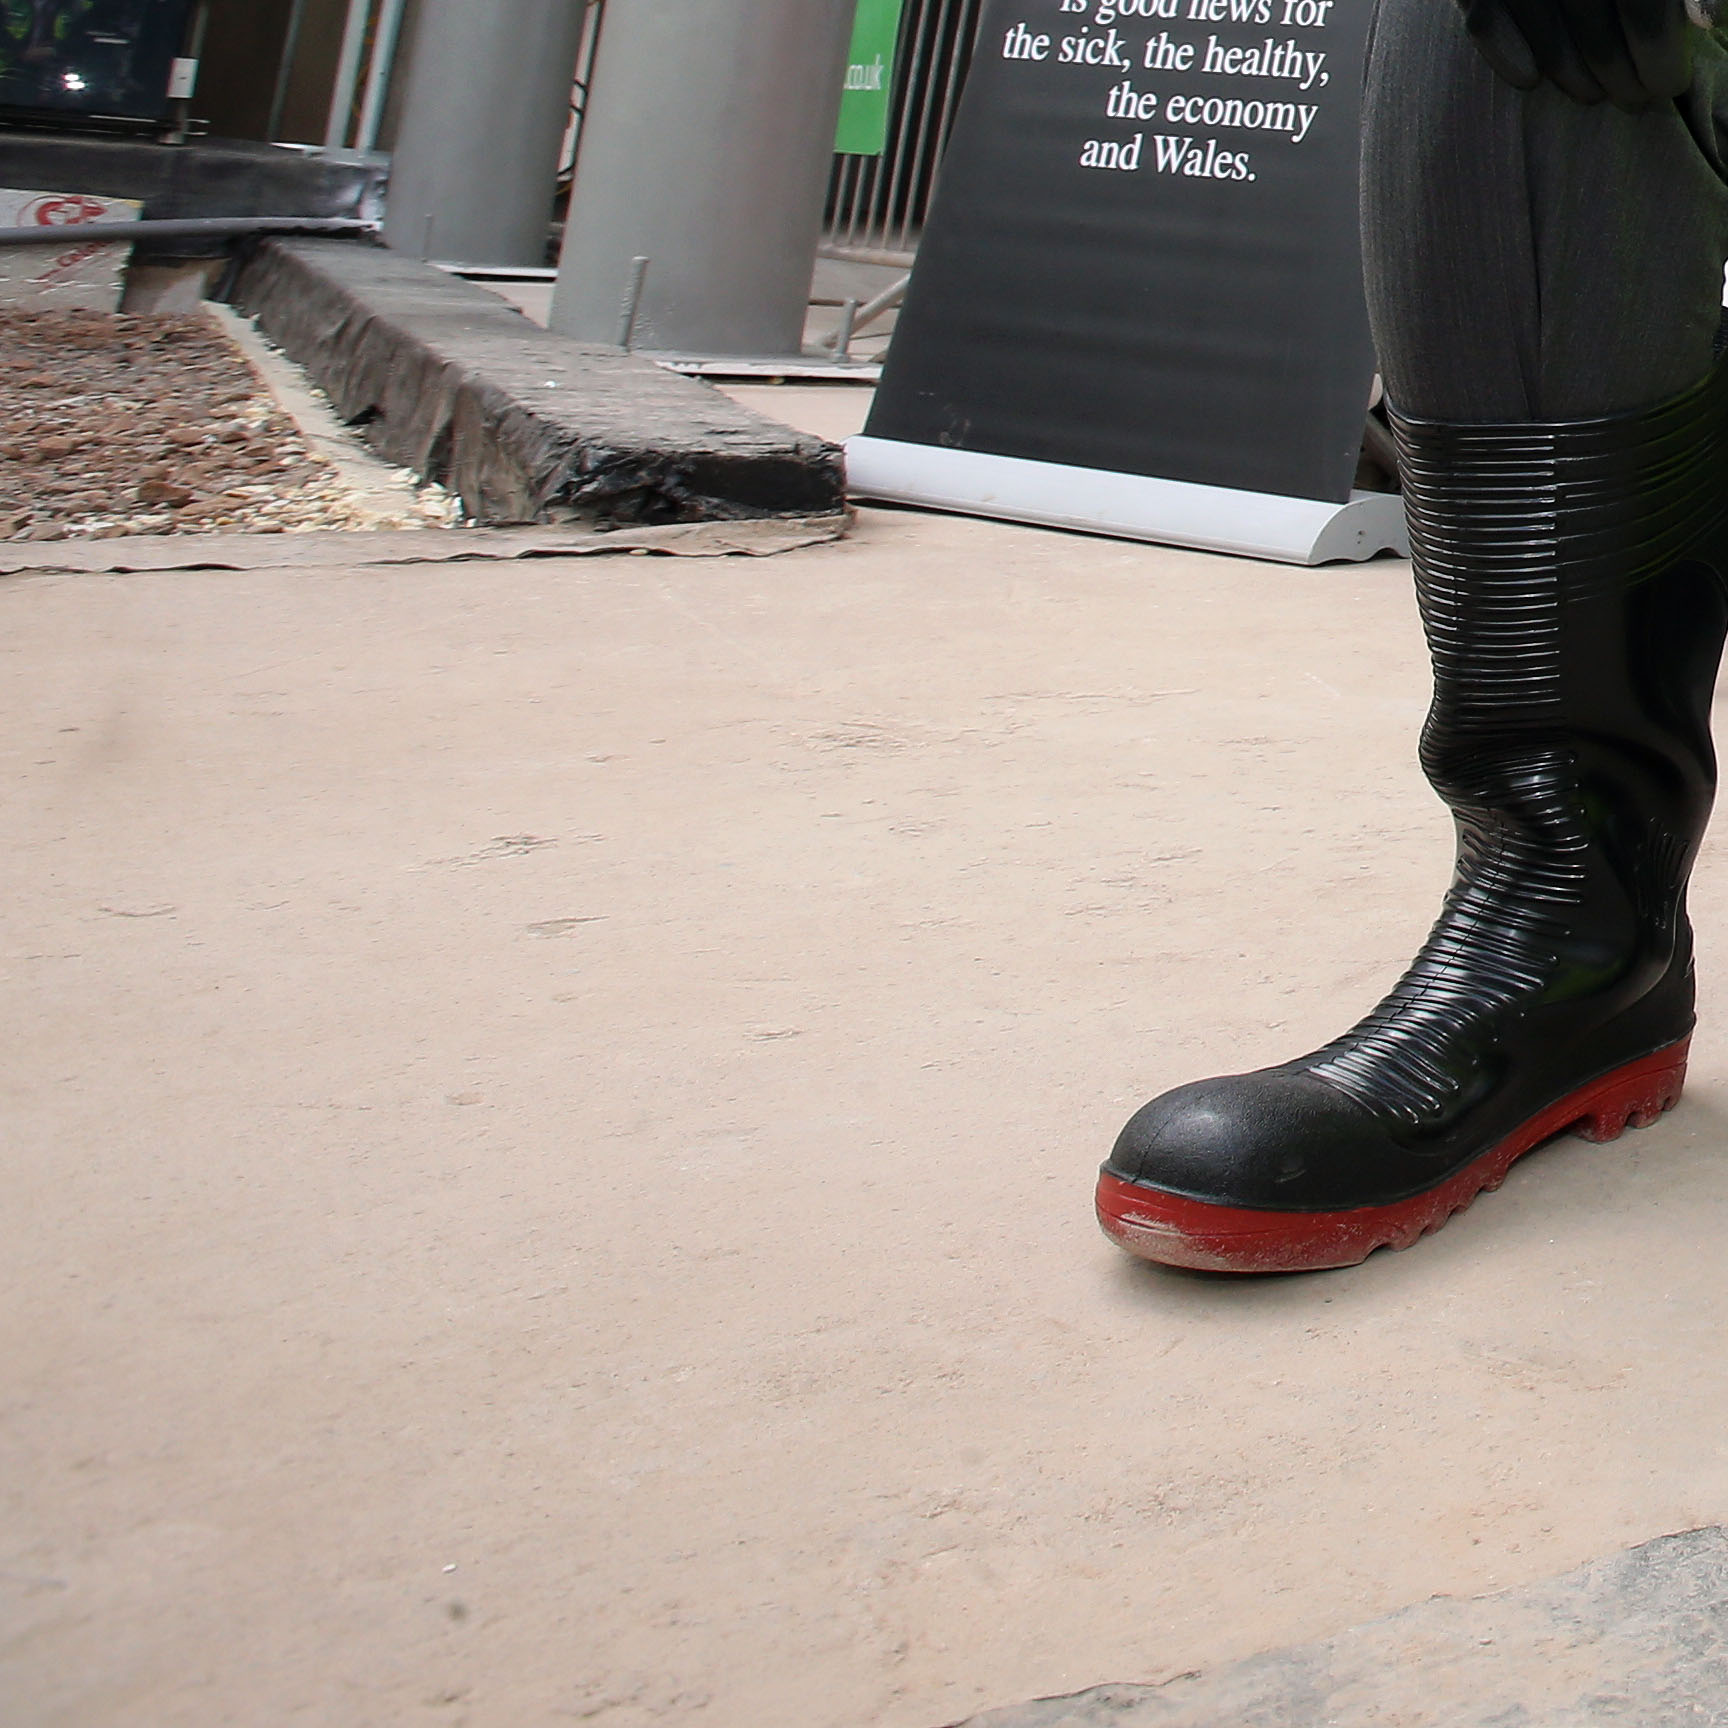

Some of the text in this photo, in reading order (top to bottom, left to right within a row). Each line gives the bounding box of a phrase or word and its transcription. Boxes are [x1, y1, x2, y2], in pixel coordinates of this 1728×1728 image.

[1002, 23, 1330, 90] the sick, the healthy,
[1105, 81, 1318, 143] the economy
[1080, 134, 1258, 181] and Wales.
